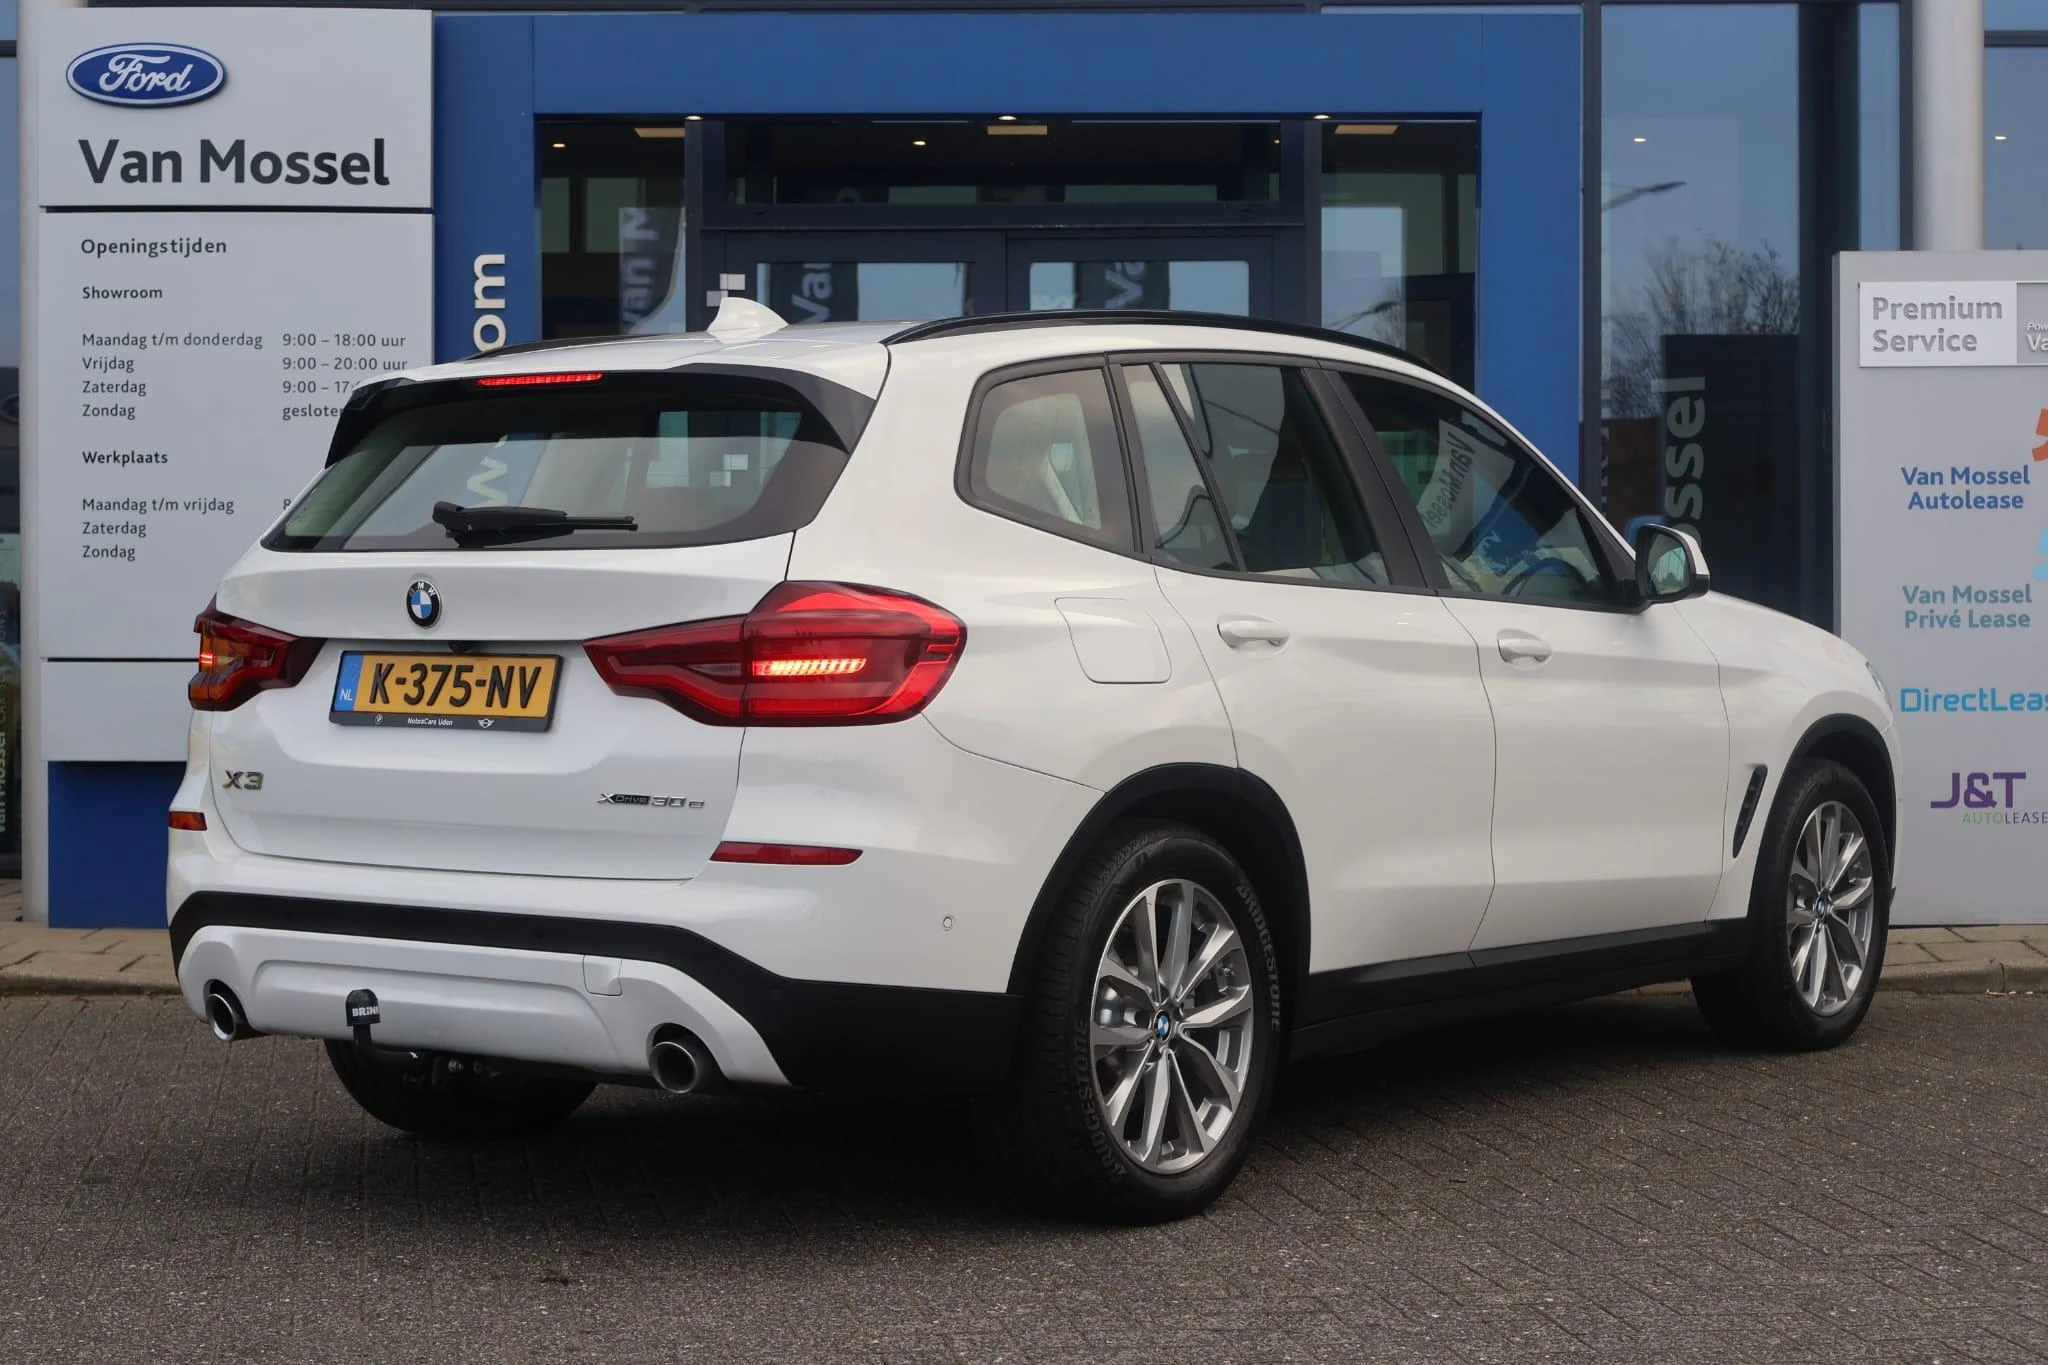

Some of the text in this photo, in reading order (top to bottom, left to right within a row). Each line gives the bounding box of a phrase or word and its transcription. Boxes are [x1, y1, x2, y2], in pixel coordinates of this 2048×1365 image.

[98, 53, 194, 92] Ford
[77, 137, 391, 186] Van Mossel
[80, 237, 227, 259] Openingstijden
[82, 285, 163, 300] Showroom
[1872, 294, 2003, 321] Premium
[82, 332, 148, 350] Maandag
[151, 332, 179, 347] t/m
[183, 331, 263, 350] donderdag
[282, 333, 317, 347] 9:00
[334, 333, 376, 347] 18:00
[381, 337, 407, 347] uur
[1872, 327, 1978, 353] Service
[81, 356, 135, 374] Vrijdag
[282, 356, 317, 370] 9:00
[333, 357, 378, 370] 20:00
[383, 360, 408, 371] uur
[82, 379, 147, 397] Zaterdag
[282, 380, 317, 394] 9:00
[333, 380, 361, 394] 17:
[82, 403, 136, 421] Zondag
[81, 450, 168, 468] Werkplaats
[1900, 464, 2031, 486] Van Mossel
[82, 497, 148, 515] Maandag
[151, 497, 179, 512] t/m
[183, 497, 235, 515] vrijdag
[1907, 489, 2024, 510] Autolease
[82, 520, 147, 538] Zaterdag
[82, 544, 136, 562] Zondag
[1902, 583, 2033, 605] Van Mossel
[1904, 608, 2031, 629] Privé Lease
[339, 688, 353, 701] NL
[368, 663, 542, 709] K-375-NV
[222, 770, 264, 790] X3
[1930, 772, 2027, 809] J&T
[1962, 811, 2048, 825] AUTOLEASE
